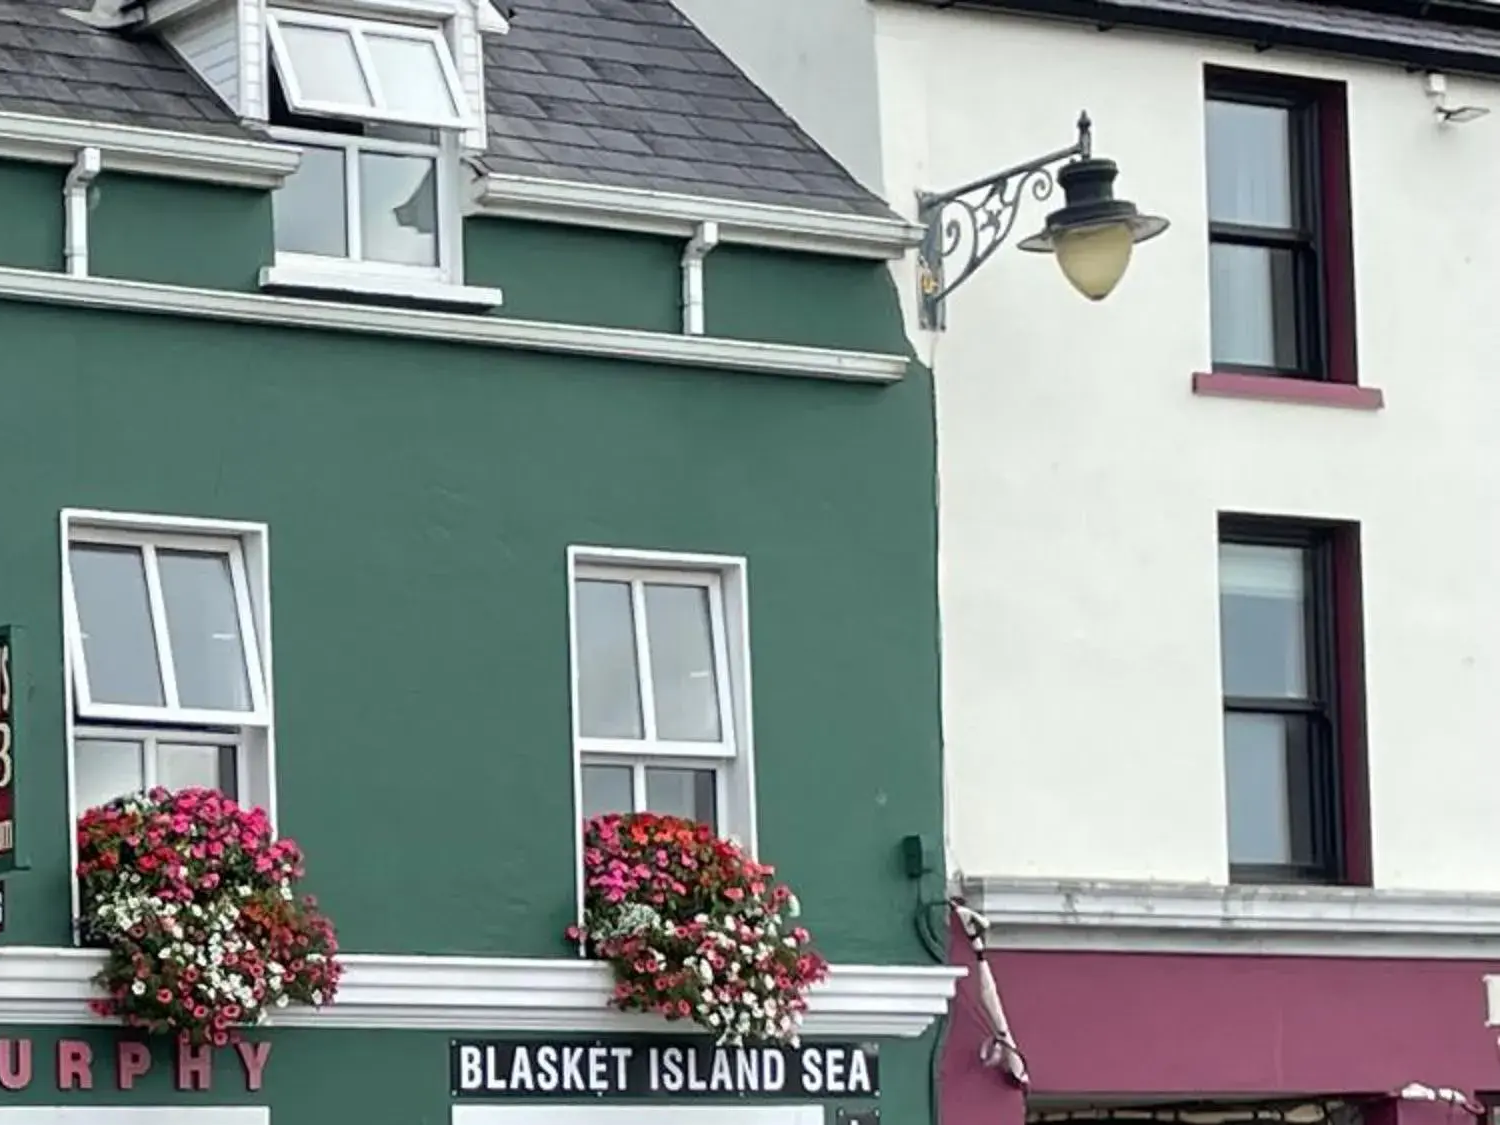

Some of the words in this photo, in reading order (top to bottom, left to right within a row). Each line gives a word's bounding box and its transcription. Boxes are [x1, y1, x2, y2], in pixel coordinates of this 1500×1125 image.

[460, 1045, 633, 1091] BLASKET
[649, 1047, 786, 1092] ISLAND
[802, 1048, 871, 1092] SEA
